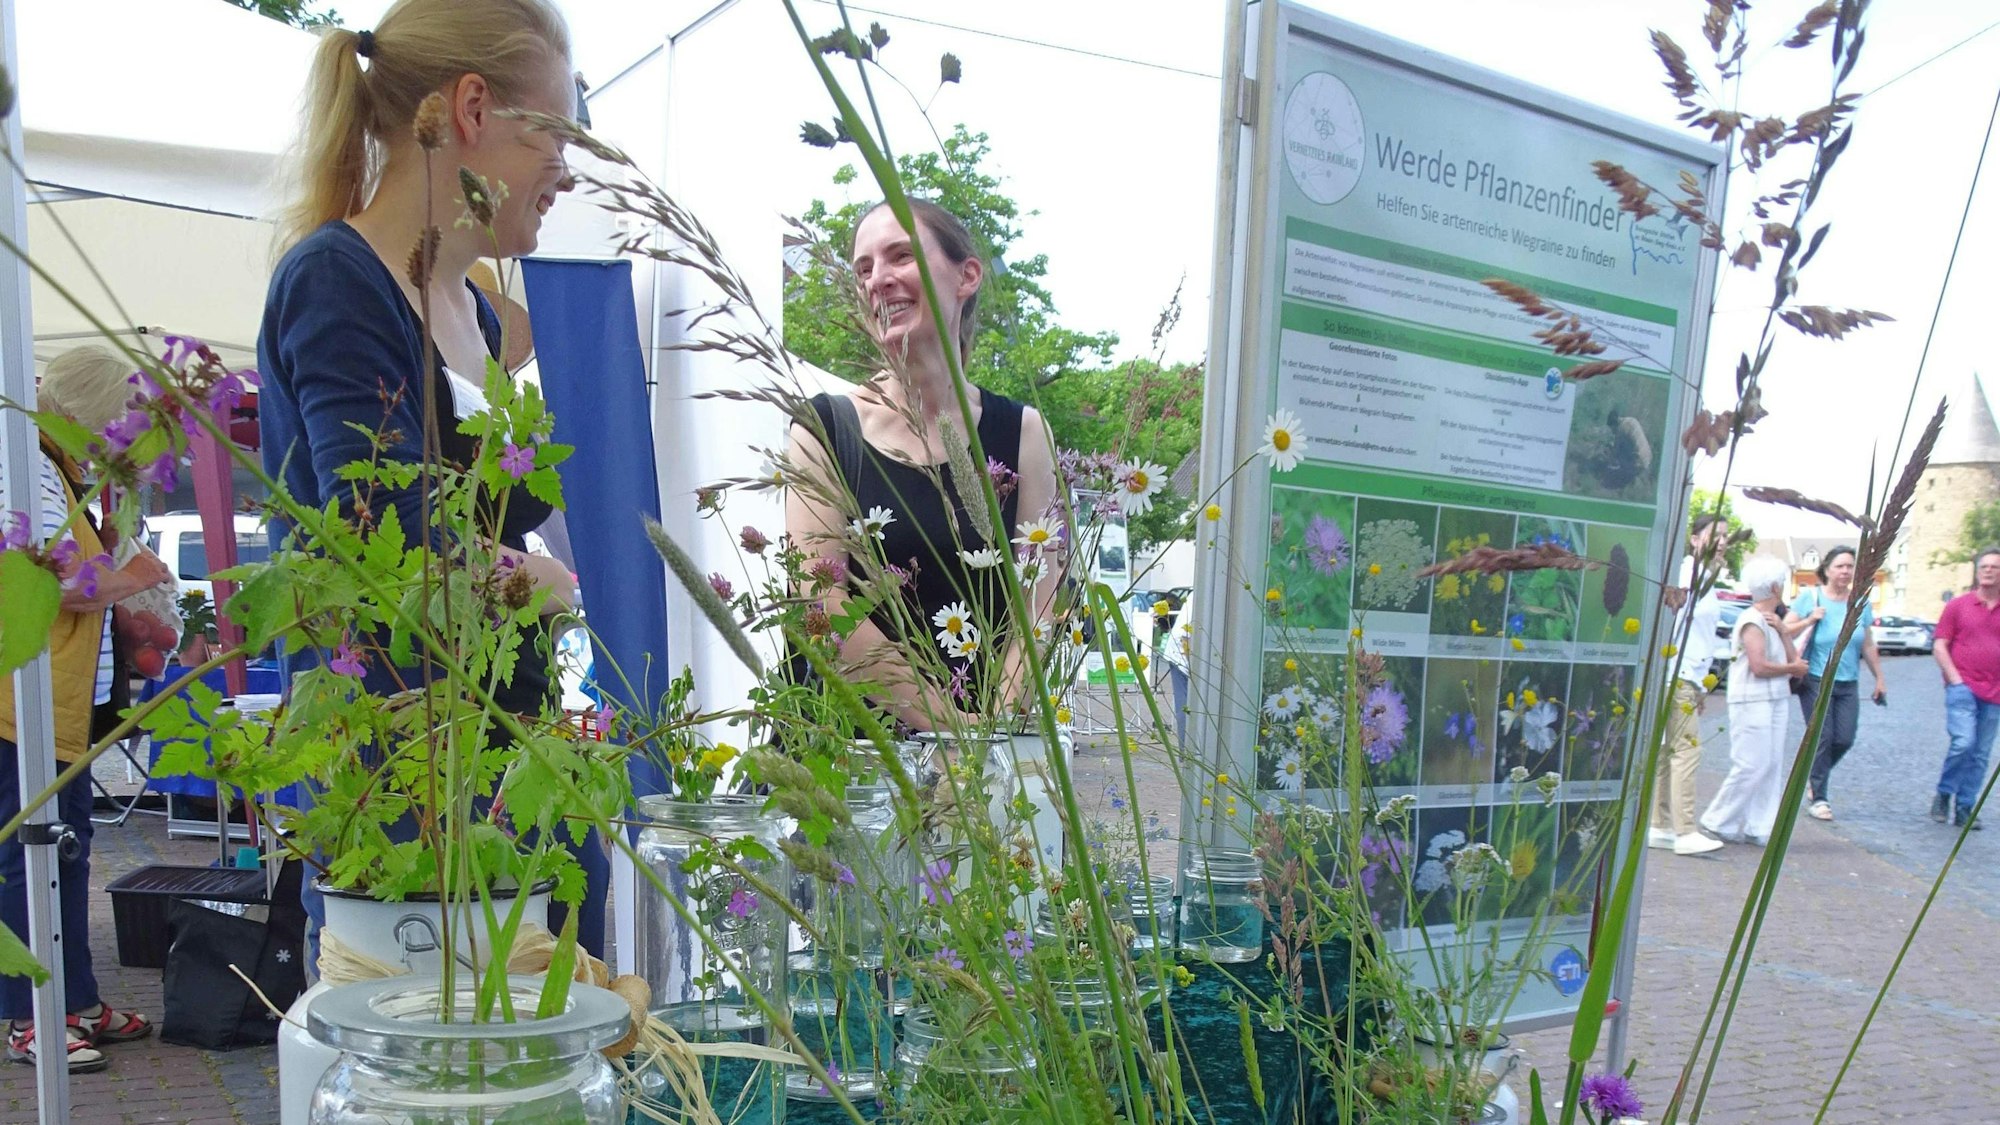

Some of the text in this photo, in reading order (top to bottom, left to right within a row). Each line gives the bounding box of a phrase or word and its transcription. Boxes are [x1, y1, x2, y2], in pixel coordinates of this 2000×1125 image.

[1327, 151, 1358, 170] RAINLAND
[1373, 130, 1625, 235] Werde Pflanzenfinder
[1377, 191, 1616, 268] Helfen Sie artenreiche Wegraine zu finden
[1322, 318, 1335, 333] So
[1336, 321, 1372, 340] können
[1373, 329, 1387, 343] Sie
[1328, 341, 1398, 362] Georeferenzierte Fotos
